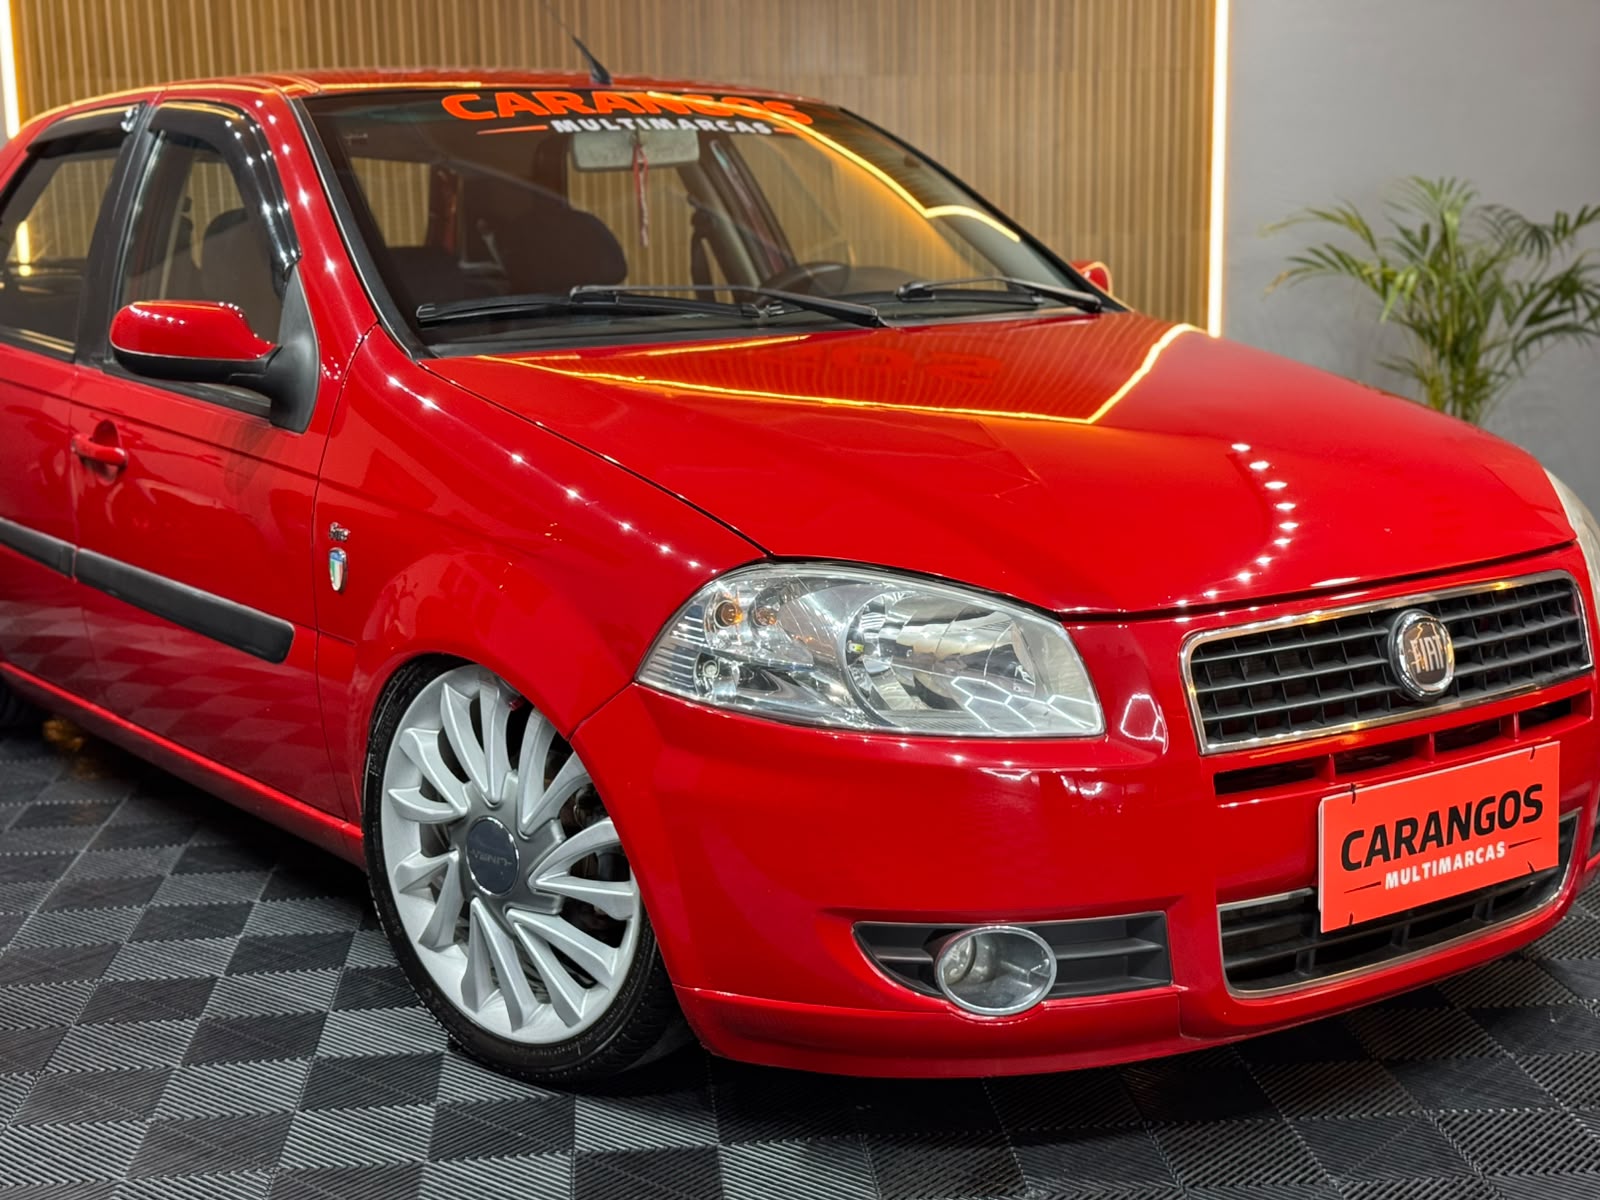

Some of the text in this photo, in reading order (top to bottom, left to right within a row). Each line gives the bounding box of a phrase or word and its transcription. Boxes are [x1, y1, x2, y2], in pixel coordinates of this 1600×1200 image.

[441, 91, 813, 125] CARANGOS
[551, 117, 772, 135] MULTIMARCAS
[1409, 635, 1445, 674] FIAT
[1341, 784, 1543, 872] CARANGOS
[1385, 841, 1506, 890] MULTIMARCAS
